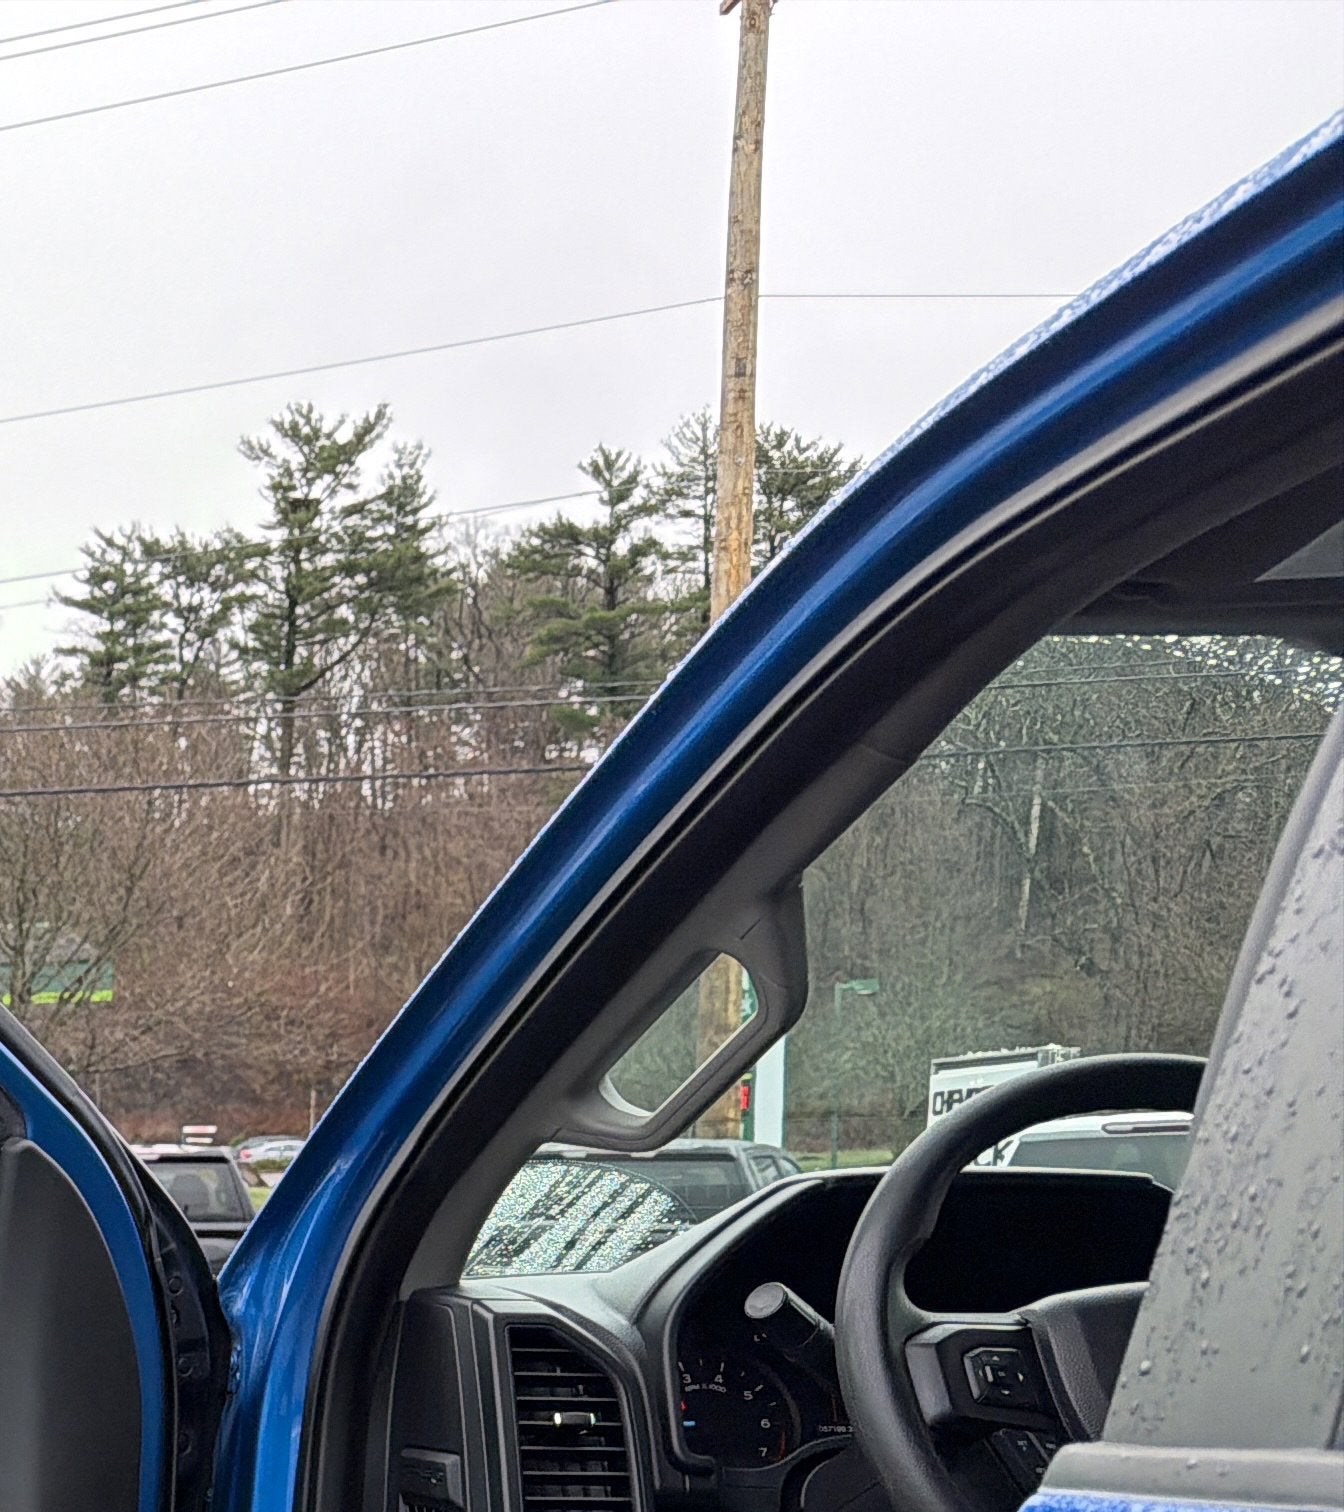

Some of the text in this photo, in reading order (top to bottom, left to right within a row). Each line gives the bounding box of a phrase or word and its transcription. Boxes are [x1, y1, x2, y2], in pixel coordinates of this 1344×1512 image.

[683, 1374, 692, 1383] 3
[714, 1374, 724, 1384] 4
[743, 1390, 754, 1401] 5
[760, 1418, 771, 1429] 6
[758, 1447, 768, 1457] 7
